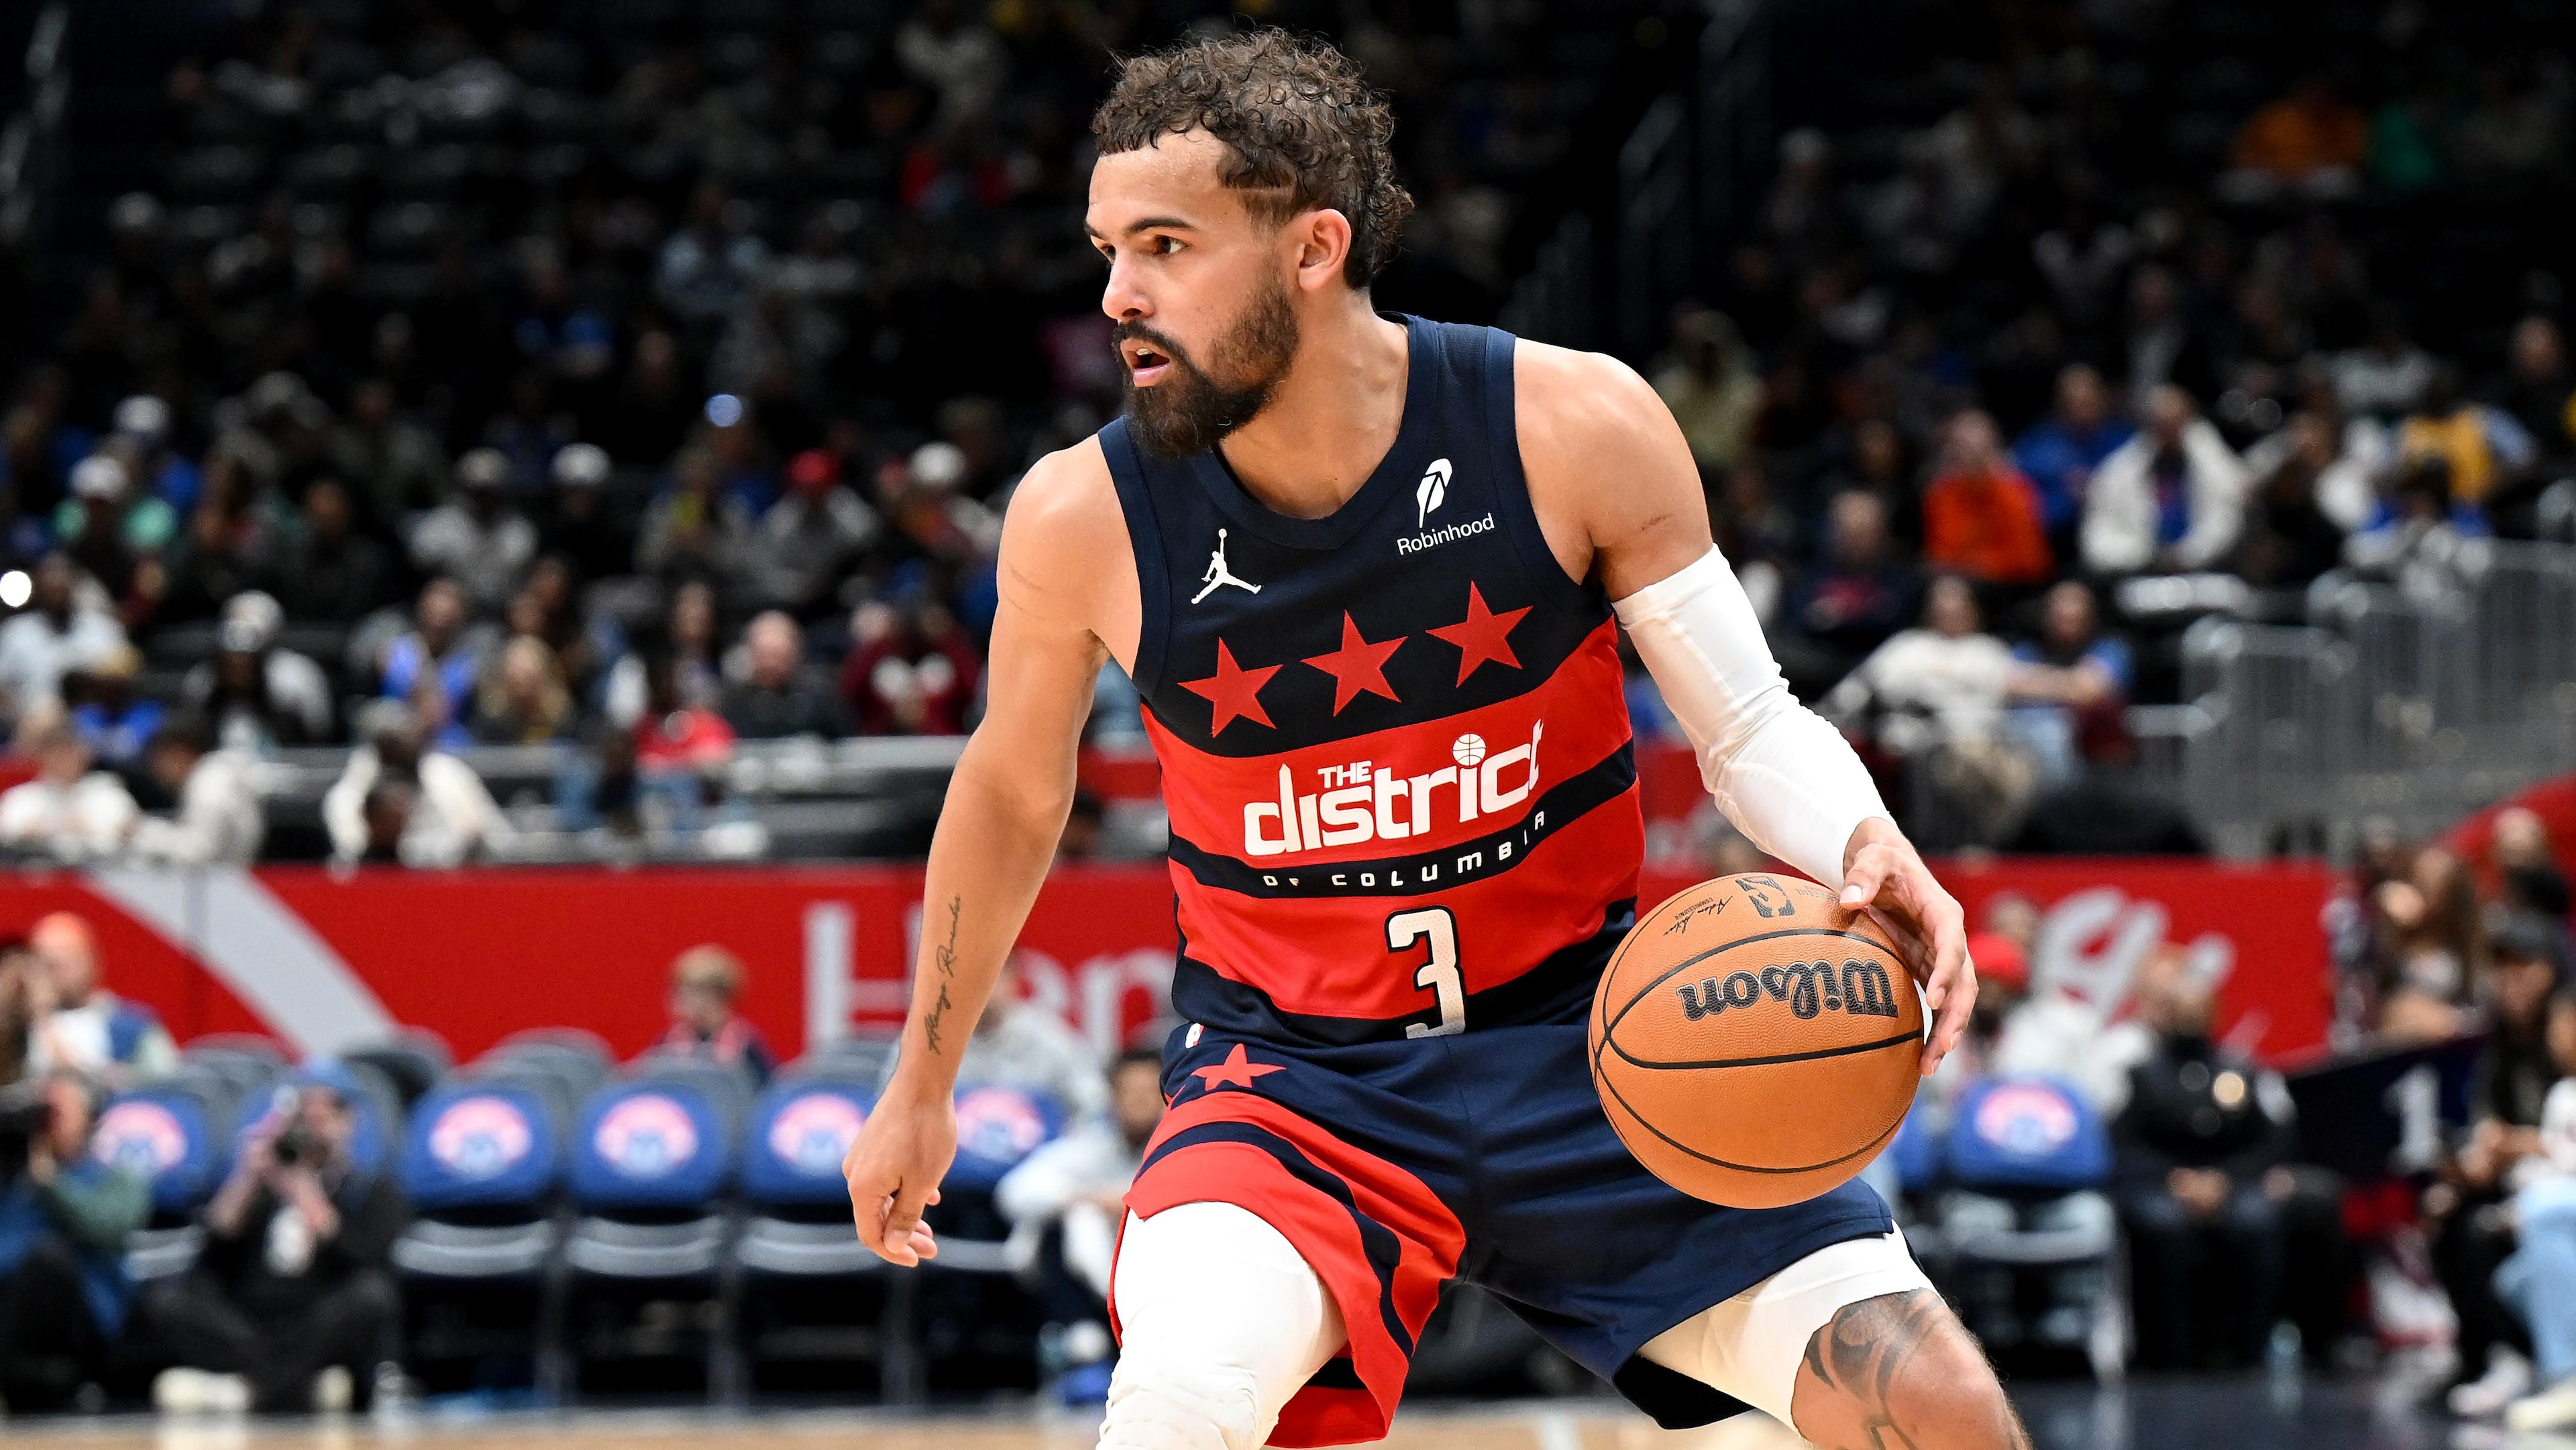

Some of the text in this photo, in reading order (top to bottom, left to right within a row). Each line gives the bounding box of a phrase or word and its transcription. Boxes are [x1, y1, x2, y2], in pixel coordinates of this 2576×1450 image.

[1397, 512, 1495, 555] Robinhood
[1244, 718, 1544, 856] district
[1318, 760, 1372, 788] THE
[1332, 810, 1544, 887] COLUMBIA
[1385, 905, 1467, 1040] 3
[1676, 959, 1898, 1021] Wilson
